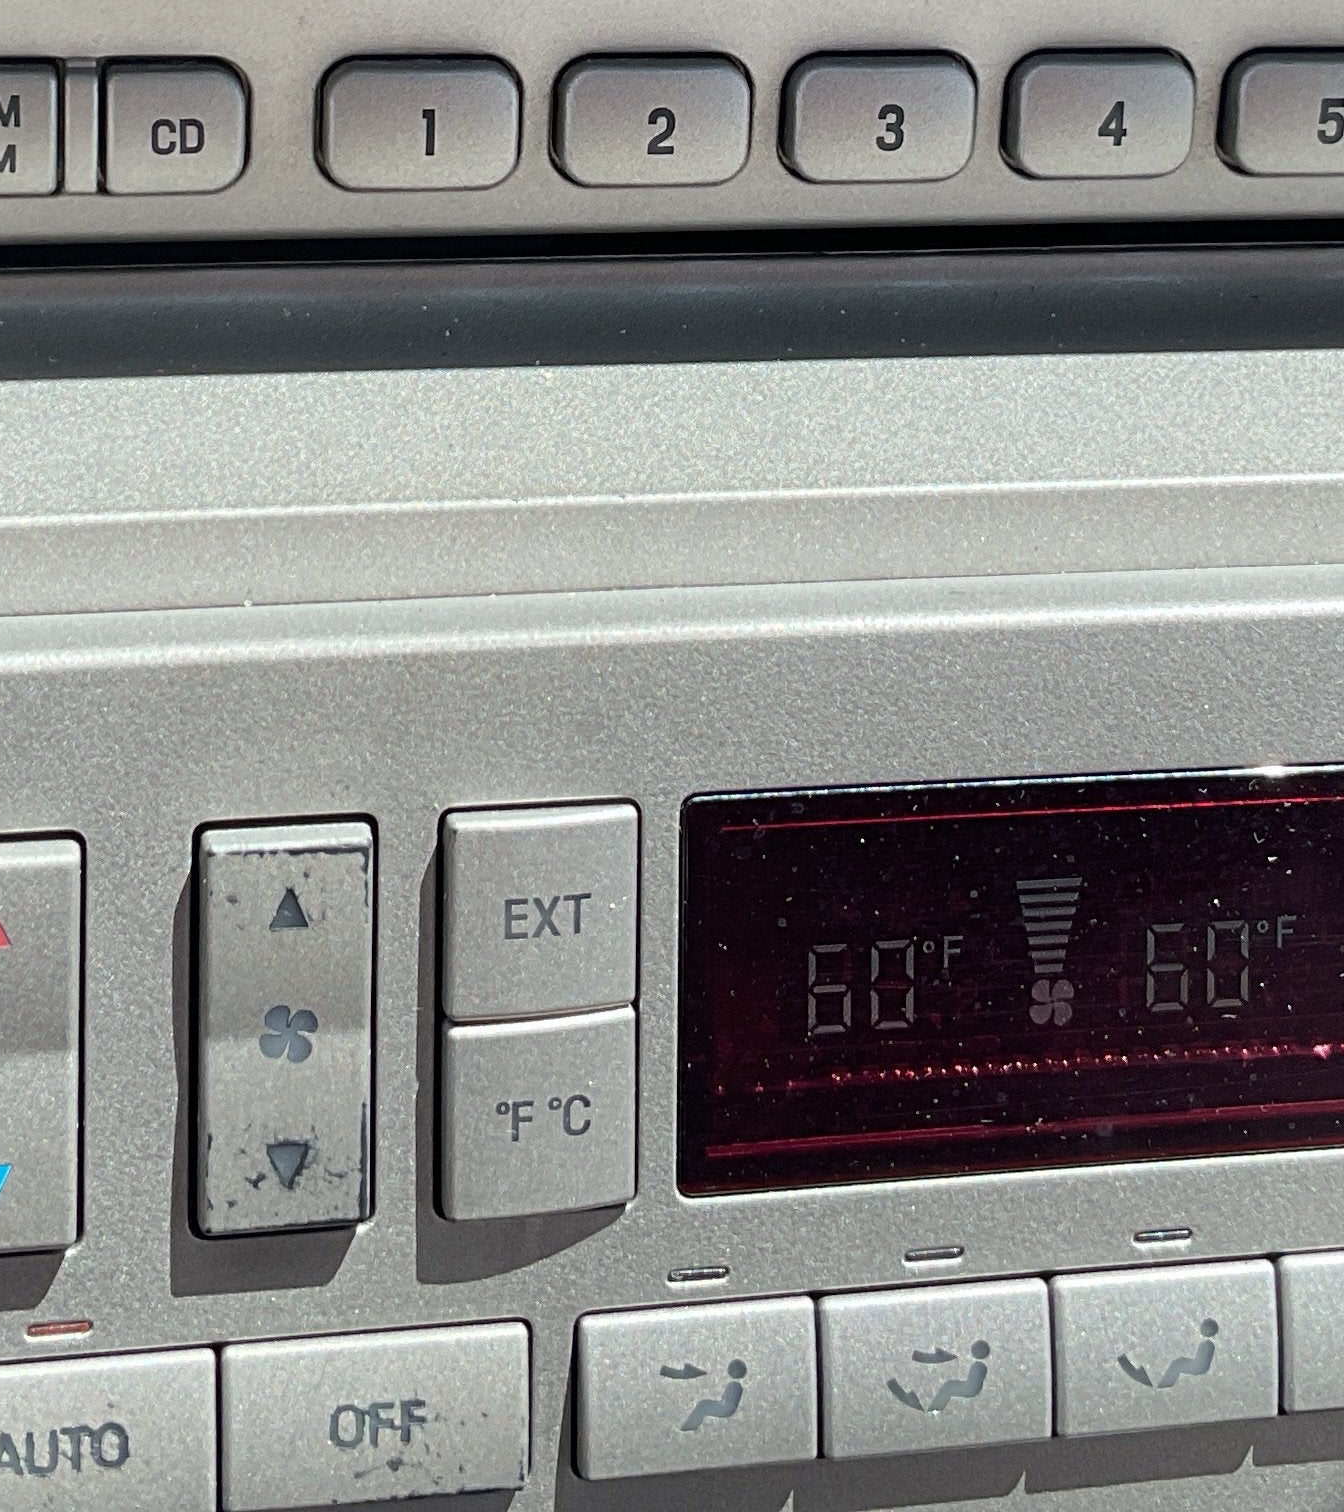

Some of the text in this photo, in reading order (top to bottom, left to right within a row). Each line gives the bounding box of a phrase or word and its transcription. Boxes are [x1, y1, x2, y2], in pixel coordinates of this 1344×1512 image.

[149, 119, 206, 156] CD
[419, 108, 437, 157] 1
[645, 105, 678, 157] 2
[874, 102, 907, 153] 3
[1096, 98, 1129, 148] 4
[501, 892, 593, 942] EXT
[328, 1397, 427, 1451] OFF
